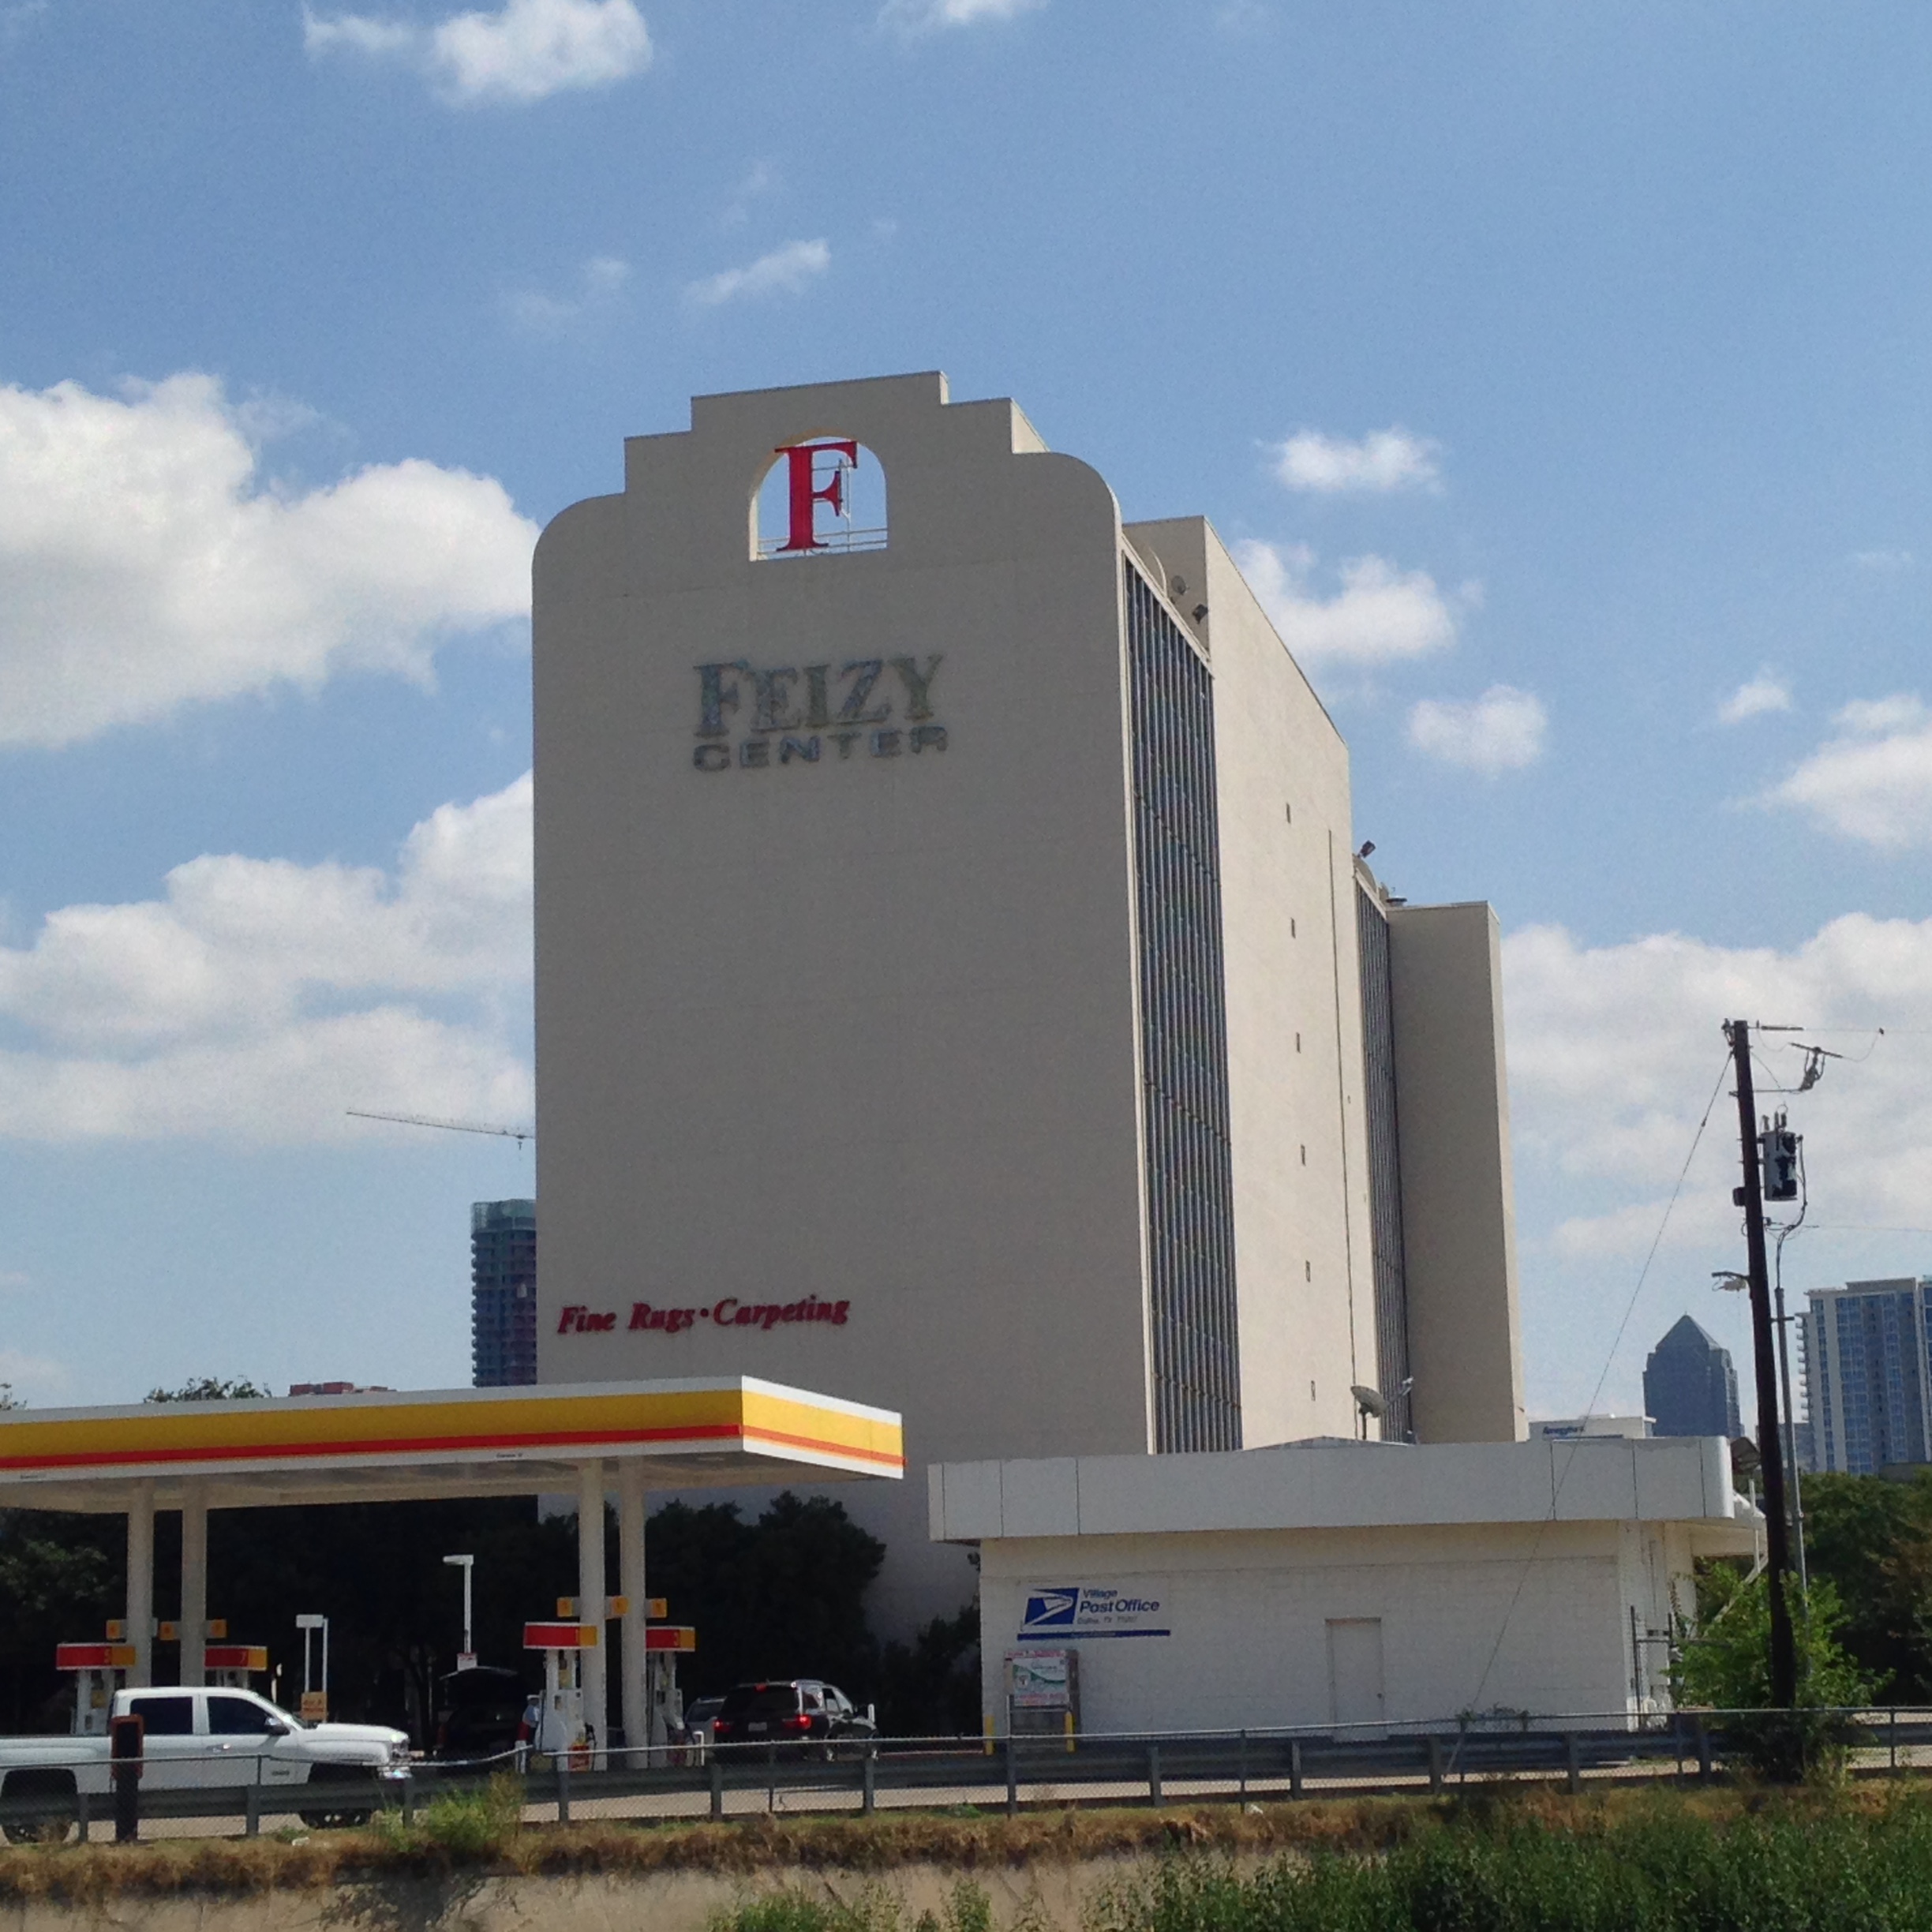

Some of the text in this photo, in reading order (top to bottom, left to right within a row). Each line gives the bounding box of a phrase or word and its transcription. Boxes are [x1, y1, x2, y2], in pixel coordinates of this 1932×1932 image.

[774, 440, 858, 551] F
[693, 654, 943, 736] FEIZY
[693, 726, 947, 772] CENTER
[557, 1294, 850, 1334] Fine Rugs Carpeting
[1080, 1599, 1160, 1613] Post Office
[1083, 1589, 1118, 1600] Village
